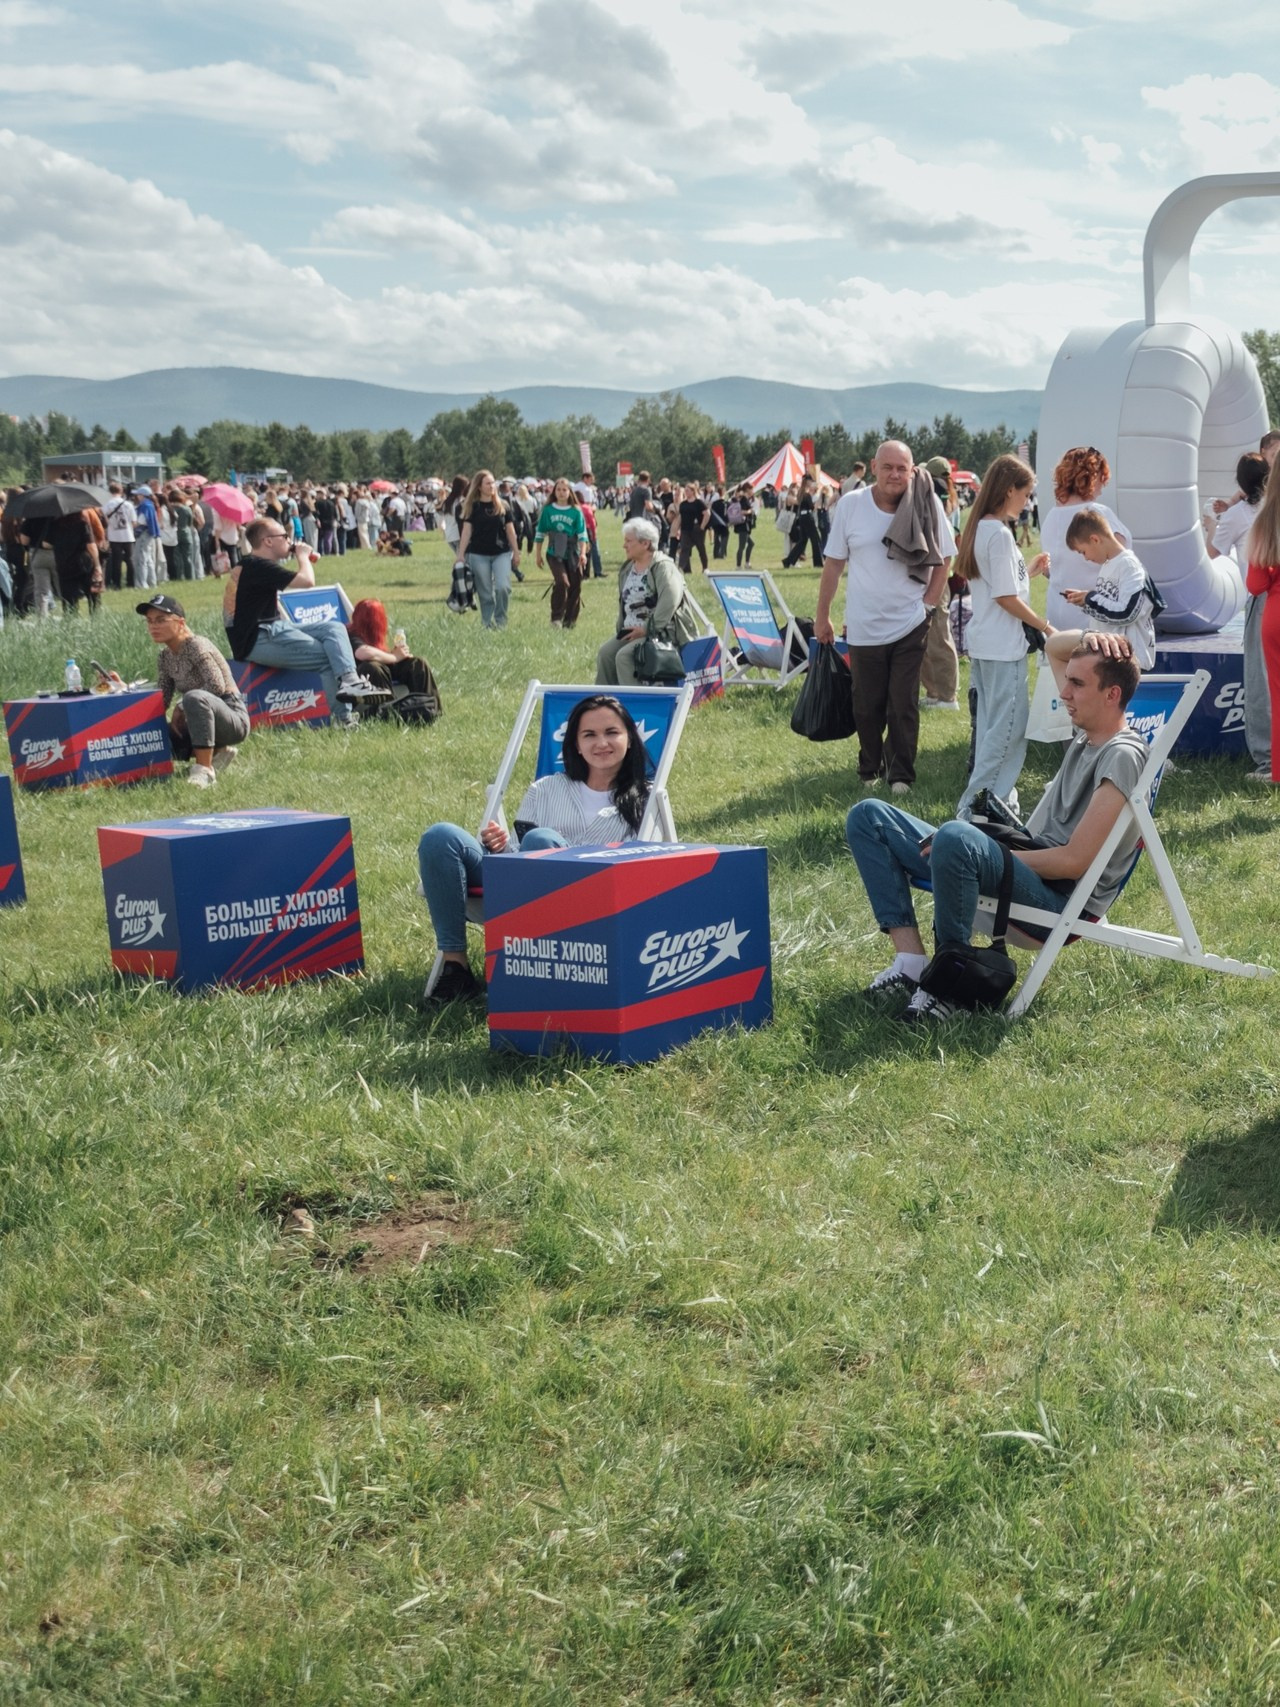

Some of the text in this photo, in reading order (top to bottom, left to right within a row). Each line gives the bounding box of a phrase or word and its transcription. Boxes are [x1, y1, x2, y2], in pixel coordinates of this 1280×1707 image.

[294, 603, 331, 619] Europa
[264, 690, 311, 704] Europa
[20, 738, 57, 755] Europa
[87, 730, 163, 751] БОЛЬШЕ ХИТОВ!
[88, 741, 165, 762] БОЛЬШЕ МУЗЫКИ!
[114, 893, 157, 919] Europa
[205, 887, 346, 925] БОЛЬШЕ ХИТОВ!
[207, 906, 347, 942] БОЛЬШЕ МУЗЫКИ!
[504, 935, 608, 964] БОЛЬШЕ ХИТОВ!
[639, 921, 730, 965] Europa
[505, 958, 609, 985] БОЛЬШЕ МУЗЫКИ!
